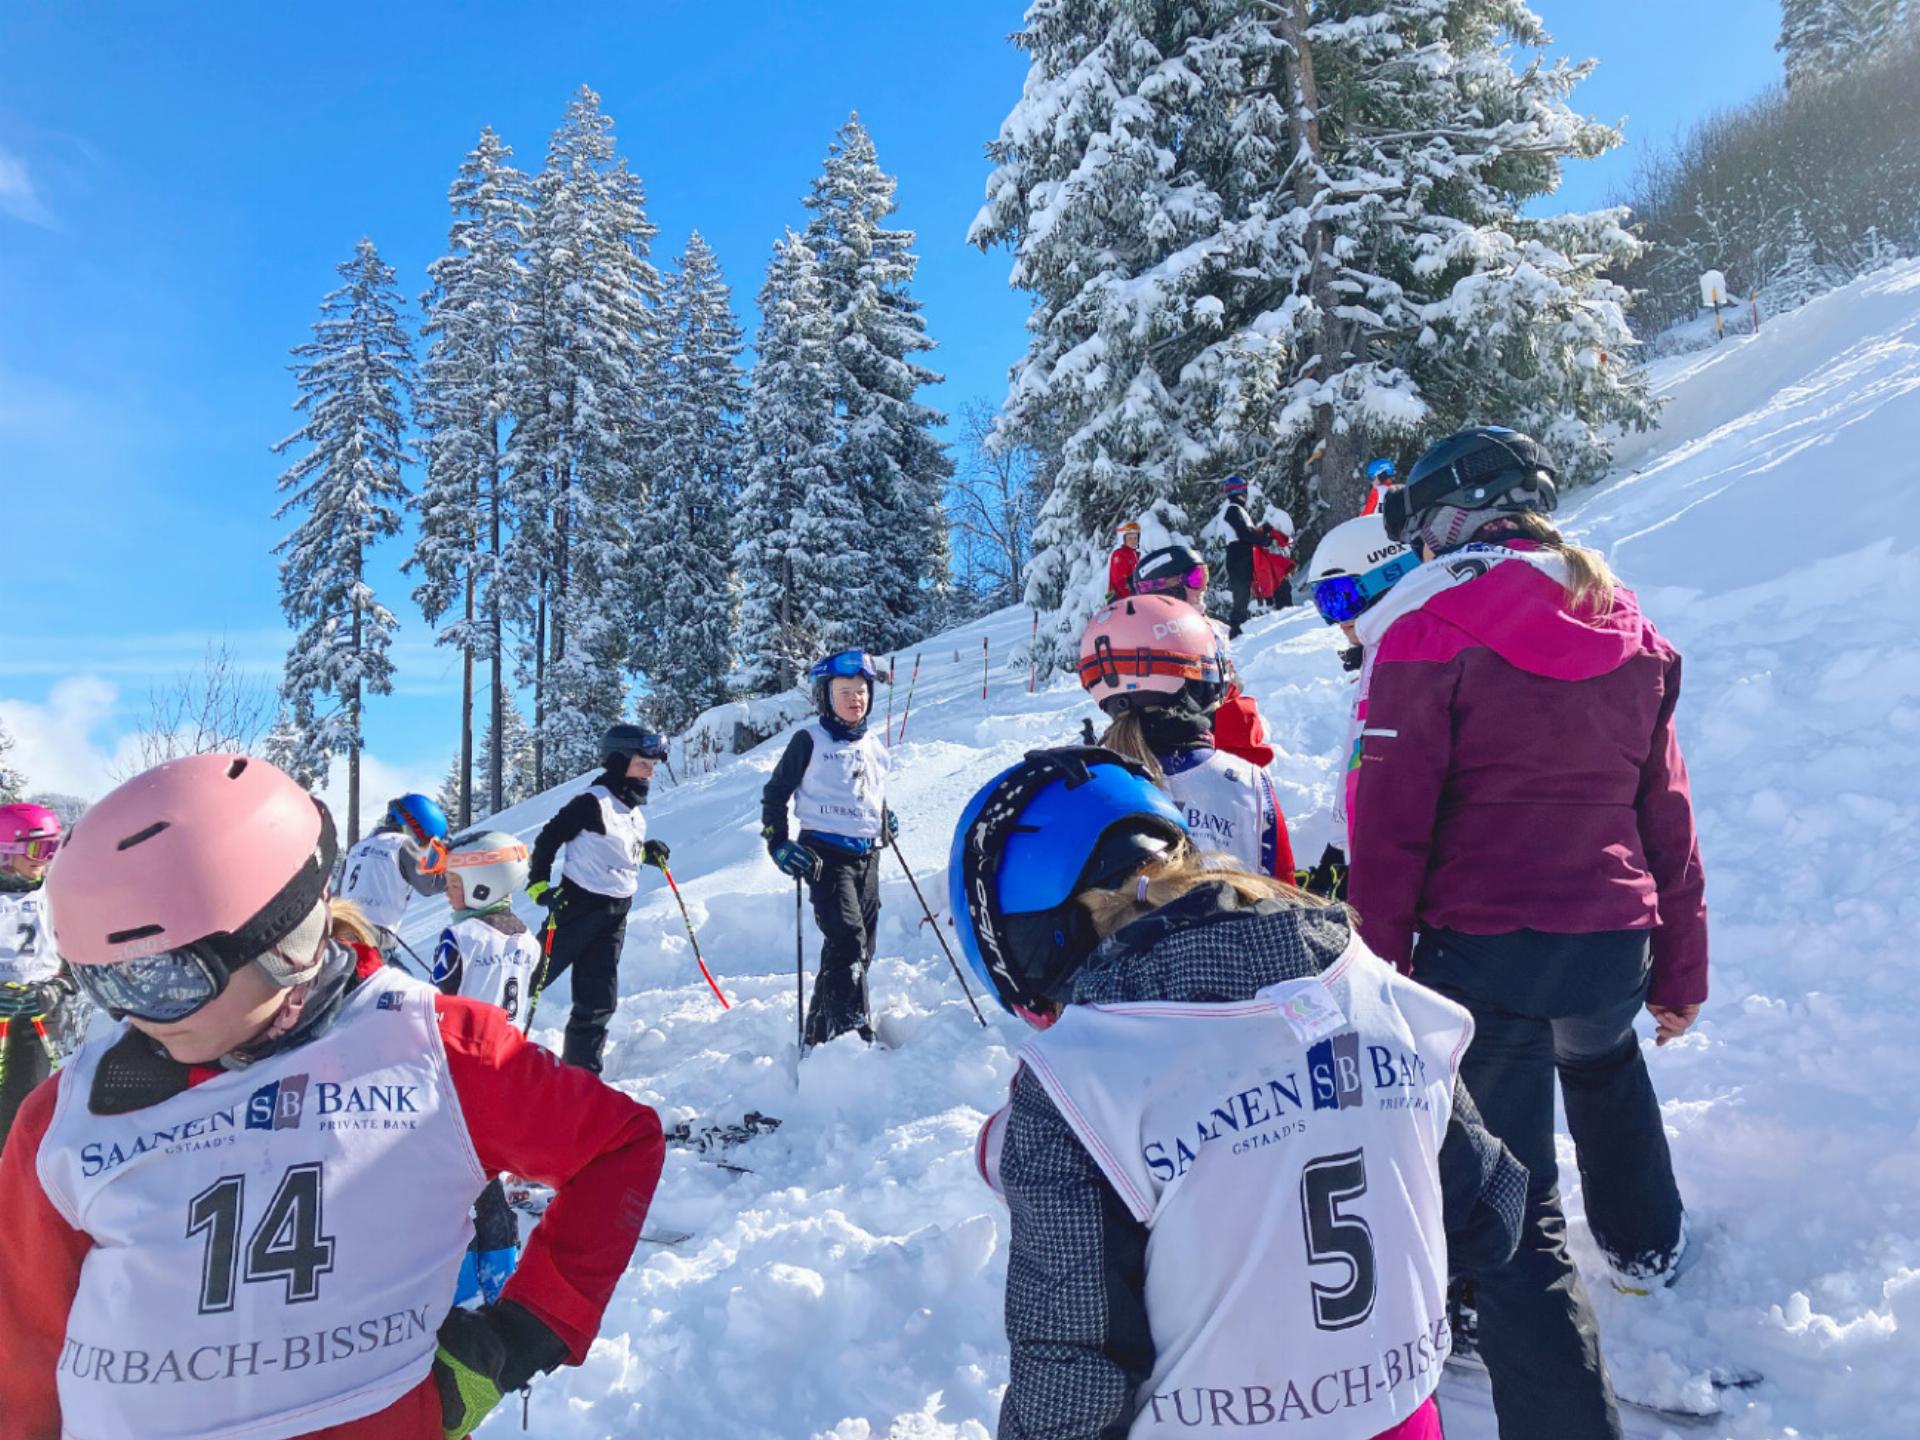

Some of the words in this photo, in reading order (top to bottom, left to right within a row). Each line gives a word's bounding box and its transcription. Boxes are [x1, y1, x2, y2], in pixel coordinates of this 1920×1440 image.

[1366, 541, 1407, 564] uvex
[1188, 808, 1236, 839] BANK
[16, 922, 37, 956] 2
[502, 975, 519, 1021] 8
[80, 1106, 237, 1179] SAANEN
[316, 1082, 420, 1116] BANK
[319, 1119, 379, 1132] PRIVATE
[383, 1118, 417, 1130] BANK
[1144, 1072, 1304, 1182] SAANEN
[1232, 1119, 1307, 1155] GSTAAD'S
[185, 1160, 336, 1316] 14
[1300, 1145, 1377, 1332] 5
[59, 1303, 431, 1385] TURBACH-BISSEN
[1150, 1315, 1450, 1427] TURBACH-BISE
